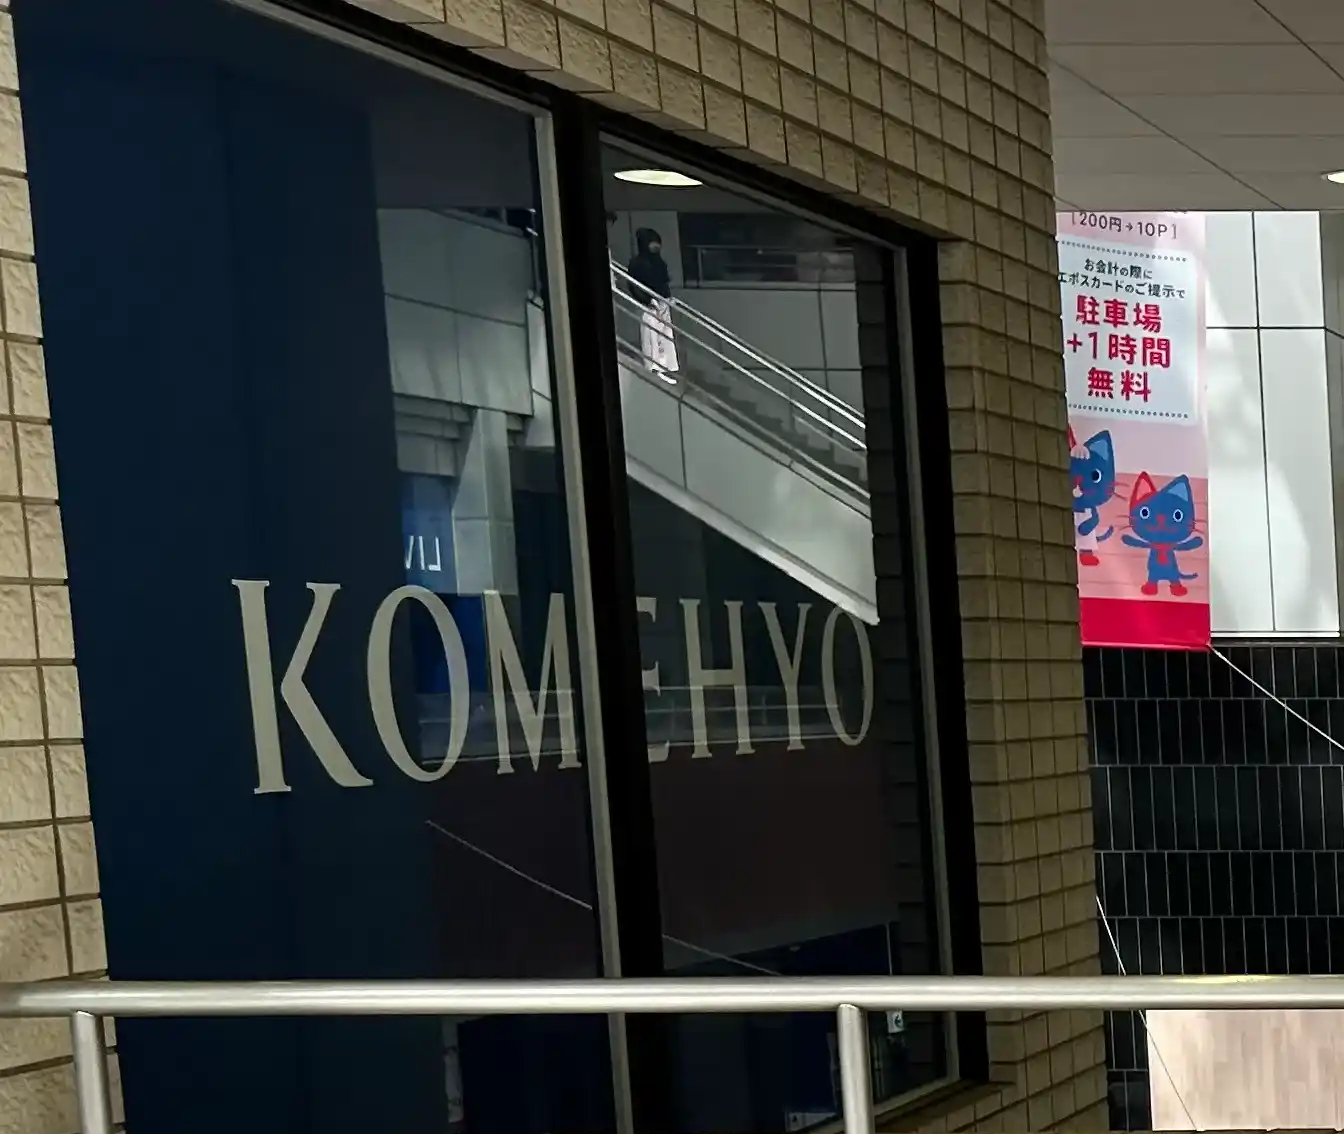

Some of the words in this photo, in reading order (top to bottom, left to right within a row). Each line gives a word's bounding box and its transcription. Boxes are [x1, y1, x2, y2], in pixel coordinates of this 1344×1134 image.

[1058, 271, 1186, 299] エポスカードのご提示で
[1084, 258, 1153, 279] お会計の際に
[1076, 294, 1162, 333] 駐車場
[1067, 331, 1171, 369] +1時間
[1088, 367, 1152, 402] 無料
